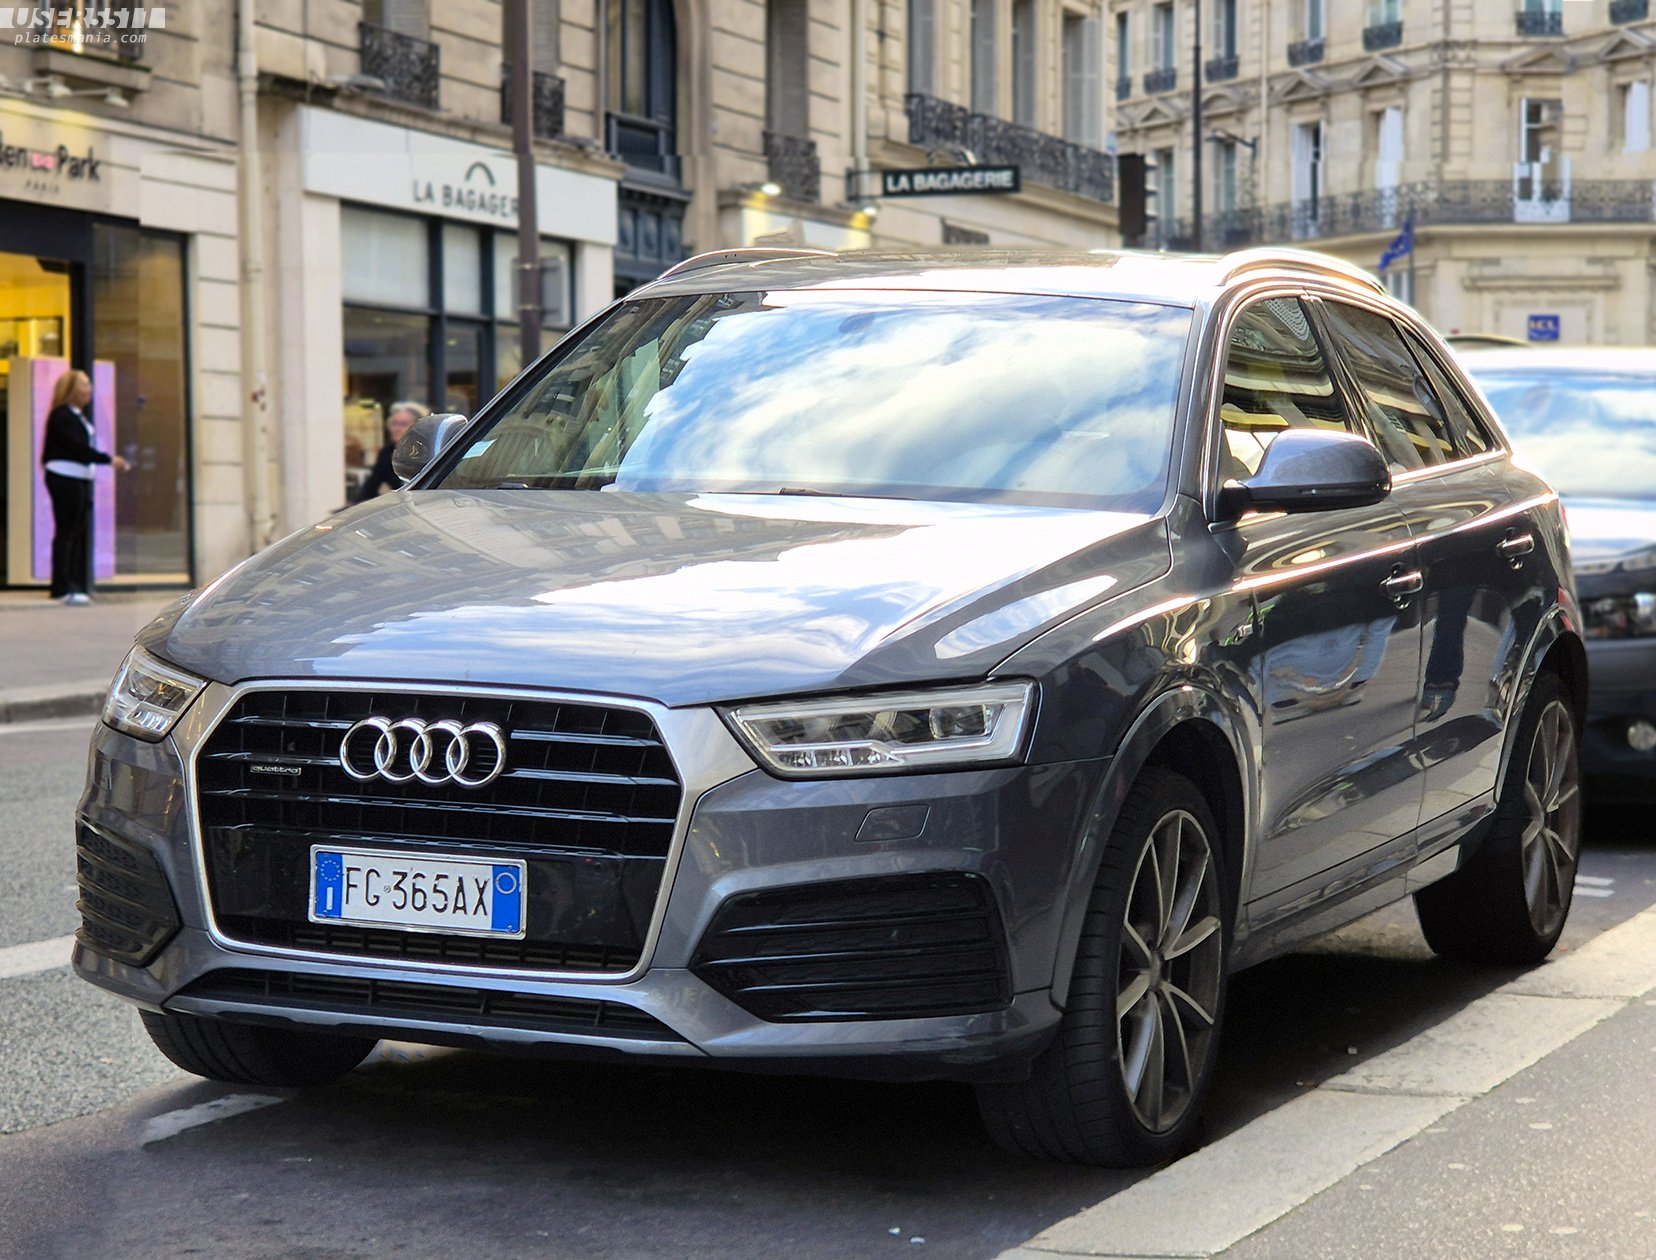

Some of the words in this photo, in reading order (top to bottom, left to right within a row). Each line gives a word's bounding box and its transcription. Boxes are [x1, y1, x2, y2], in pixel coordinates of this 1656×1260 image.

[0, 130, 28, 169] en
[56, 143, 101, 182] Park
[887, 173, 911, 192] LA
[913, 168, 1015, 191] BAGAGERIE
[413, 180, 435, 204] LA
[442, 184, 519, 218] BAGAGER
[251, 765, 300, 775] quattro
